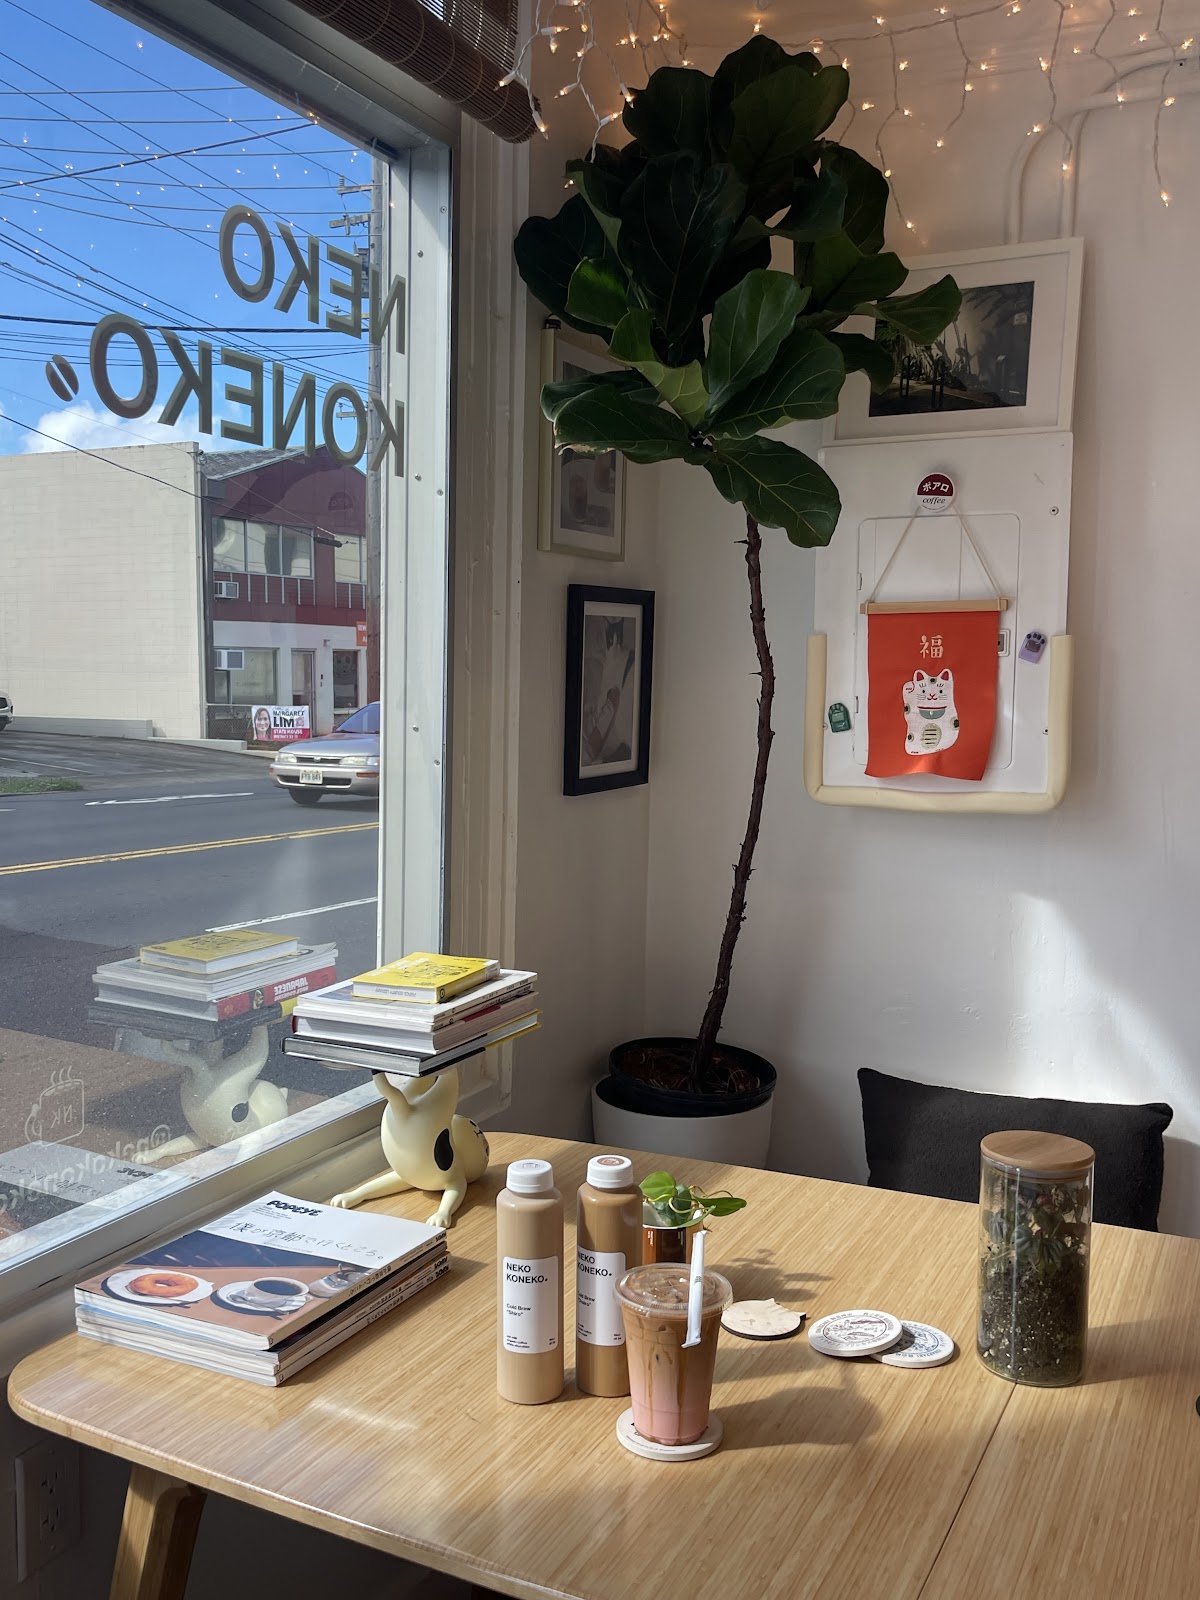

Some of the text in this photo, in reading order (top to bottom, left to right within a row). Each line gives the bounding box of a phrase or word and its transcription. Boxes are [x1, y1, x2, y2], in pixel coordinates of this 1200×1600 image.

[922, 481, 950, 493] ポアロ
[922, 496, 946, 505] coffee
[920, 634, 944, 659] 福
[273, 716, 294, 728] LIM
[266, 1200, 324, 1217] POPEYE
[506, 1262, 531, 1273] NEKO
